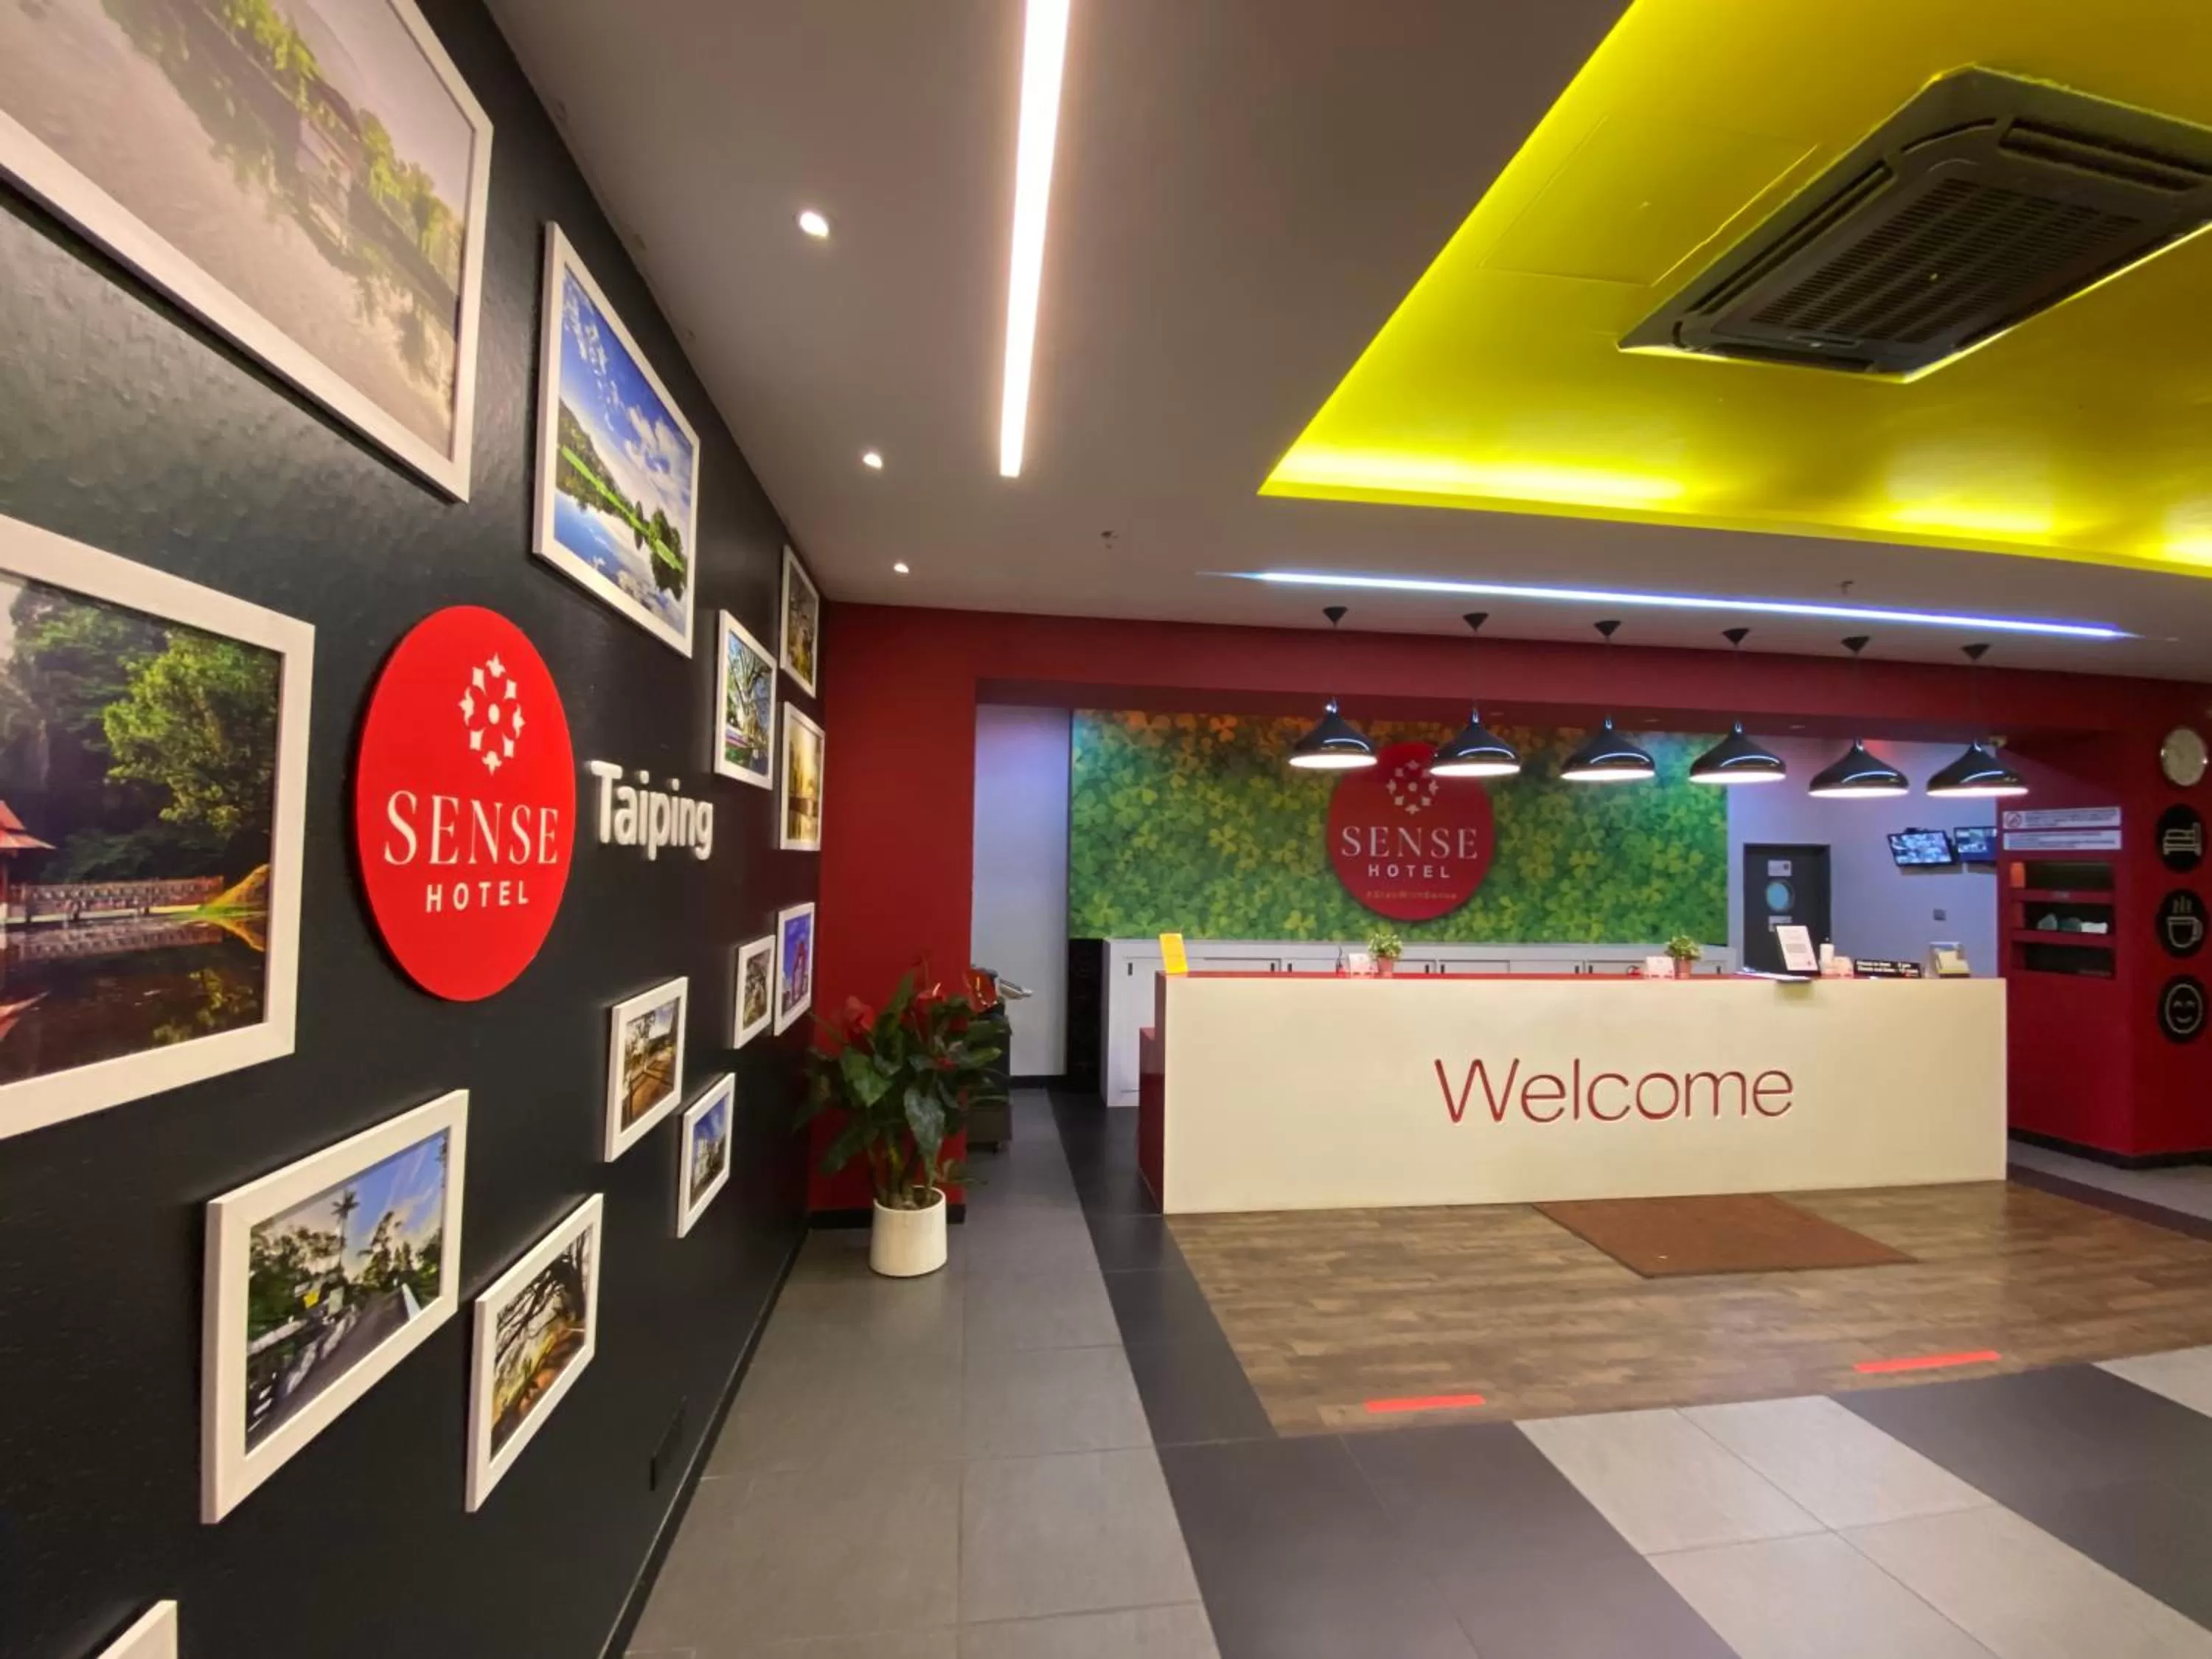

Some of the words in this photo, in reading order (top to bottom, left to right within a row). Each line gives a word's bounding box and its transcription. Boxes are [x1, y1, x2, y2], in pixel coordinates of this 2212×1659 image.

[383, 790, 559, 865] SENSE
[586, 759, 714, 861] Taiping
[1341, 825, 1478, 859] SENSE
[1368, 863, 1450, 878] HOTEL
[425, 880, 529, 913] HOTEL
[1434, 1057, 1793, 1123] Welcome
